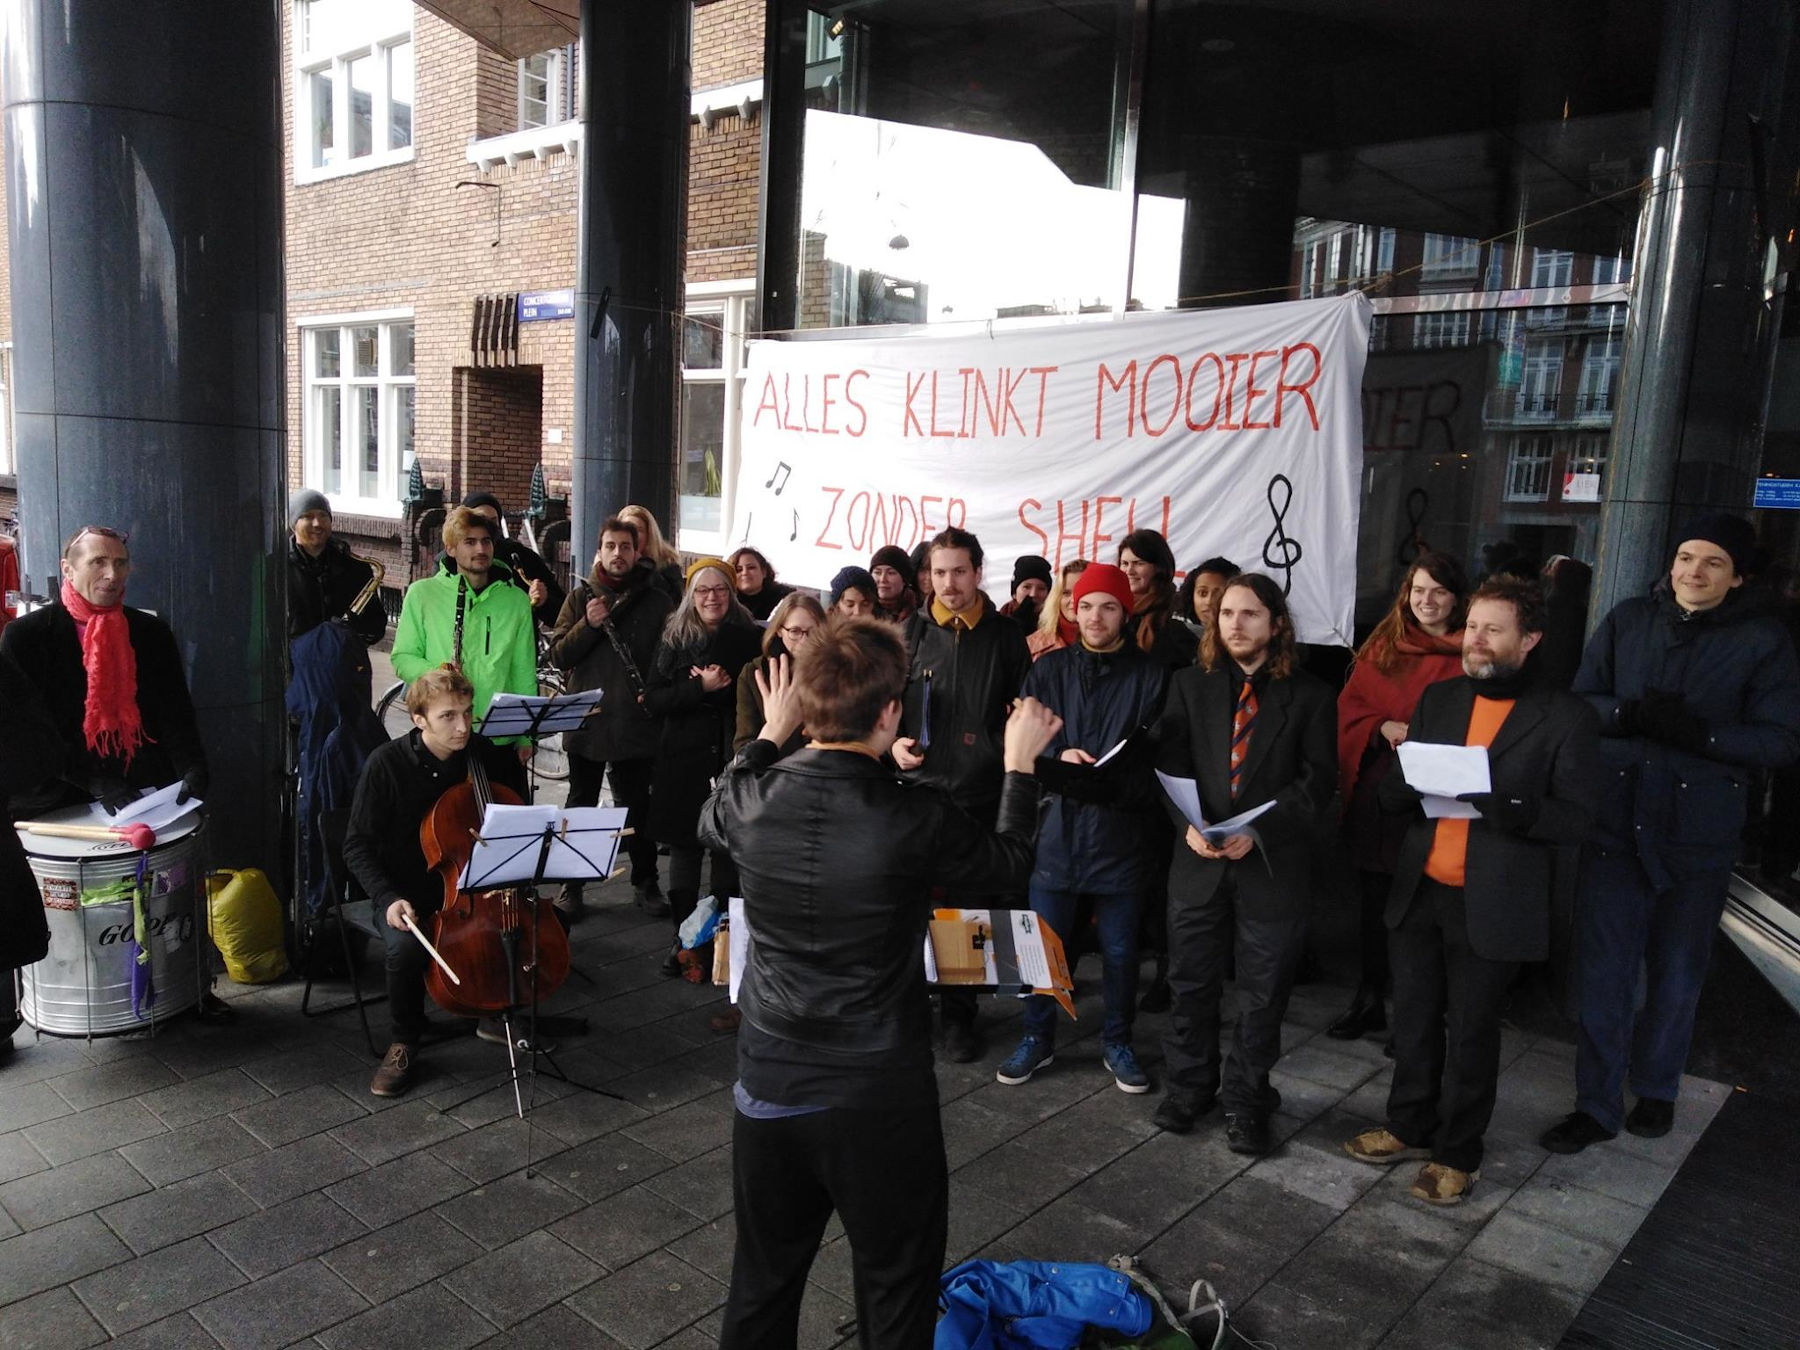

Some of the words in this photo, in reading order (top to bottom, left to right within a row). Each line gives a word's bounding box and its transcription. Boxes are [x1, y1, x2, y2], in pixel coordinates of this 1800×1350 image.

[753, 369, 870, 437] ALLES
[903, 366, 1058, 438] KLINKT
[1095, 342, 1322, 440] MOOIER
